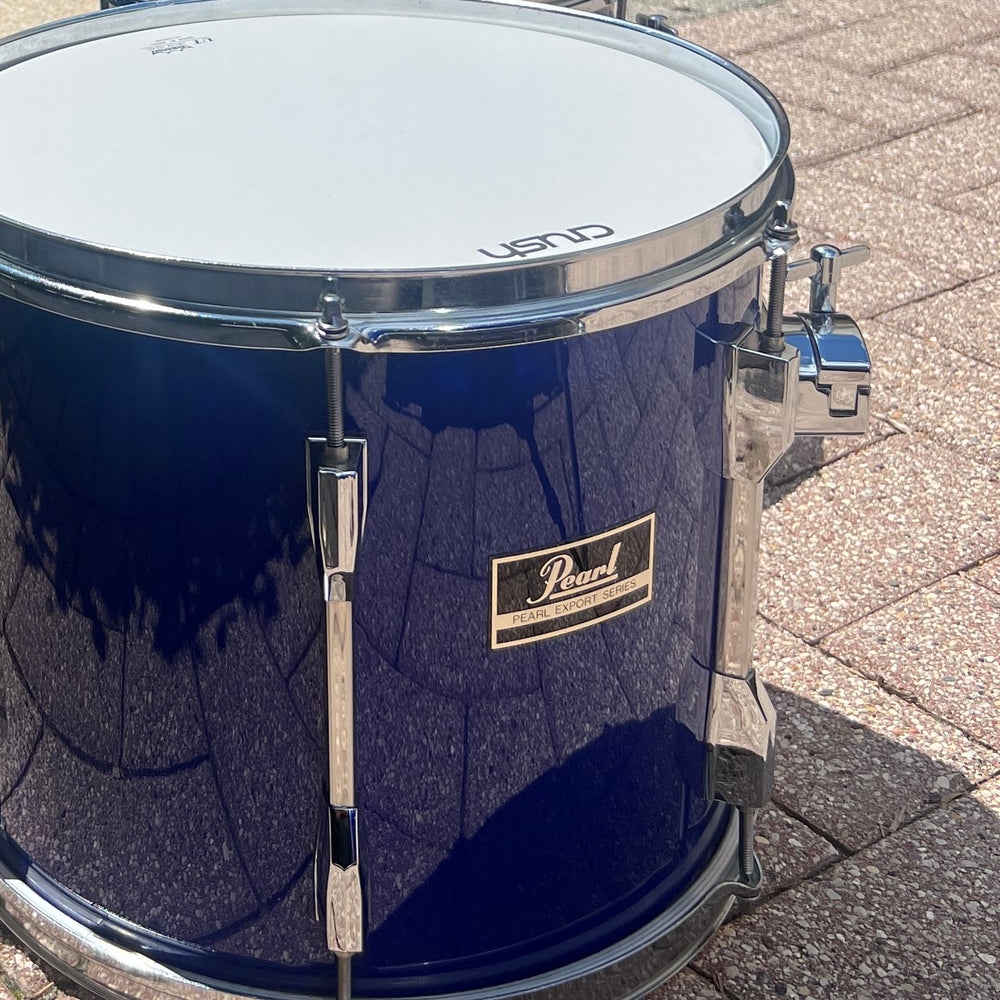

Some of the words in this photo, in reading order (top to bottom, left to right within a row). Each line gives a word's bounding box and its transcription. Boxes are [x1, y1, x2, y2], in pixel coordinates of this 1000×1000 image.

[477, 224, 615, 259] crush
[526, 542, 621, 605] Pearl
[512, 609, 550, 624] PEARL
[555, 593, 598, 615] EXPORT
[602, 578, 637, 600] SERIES
